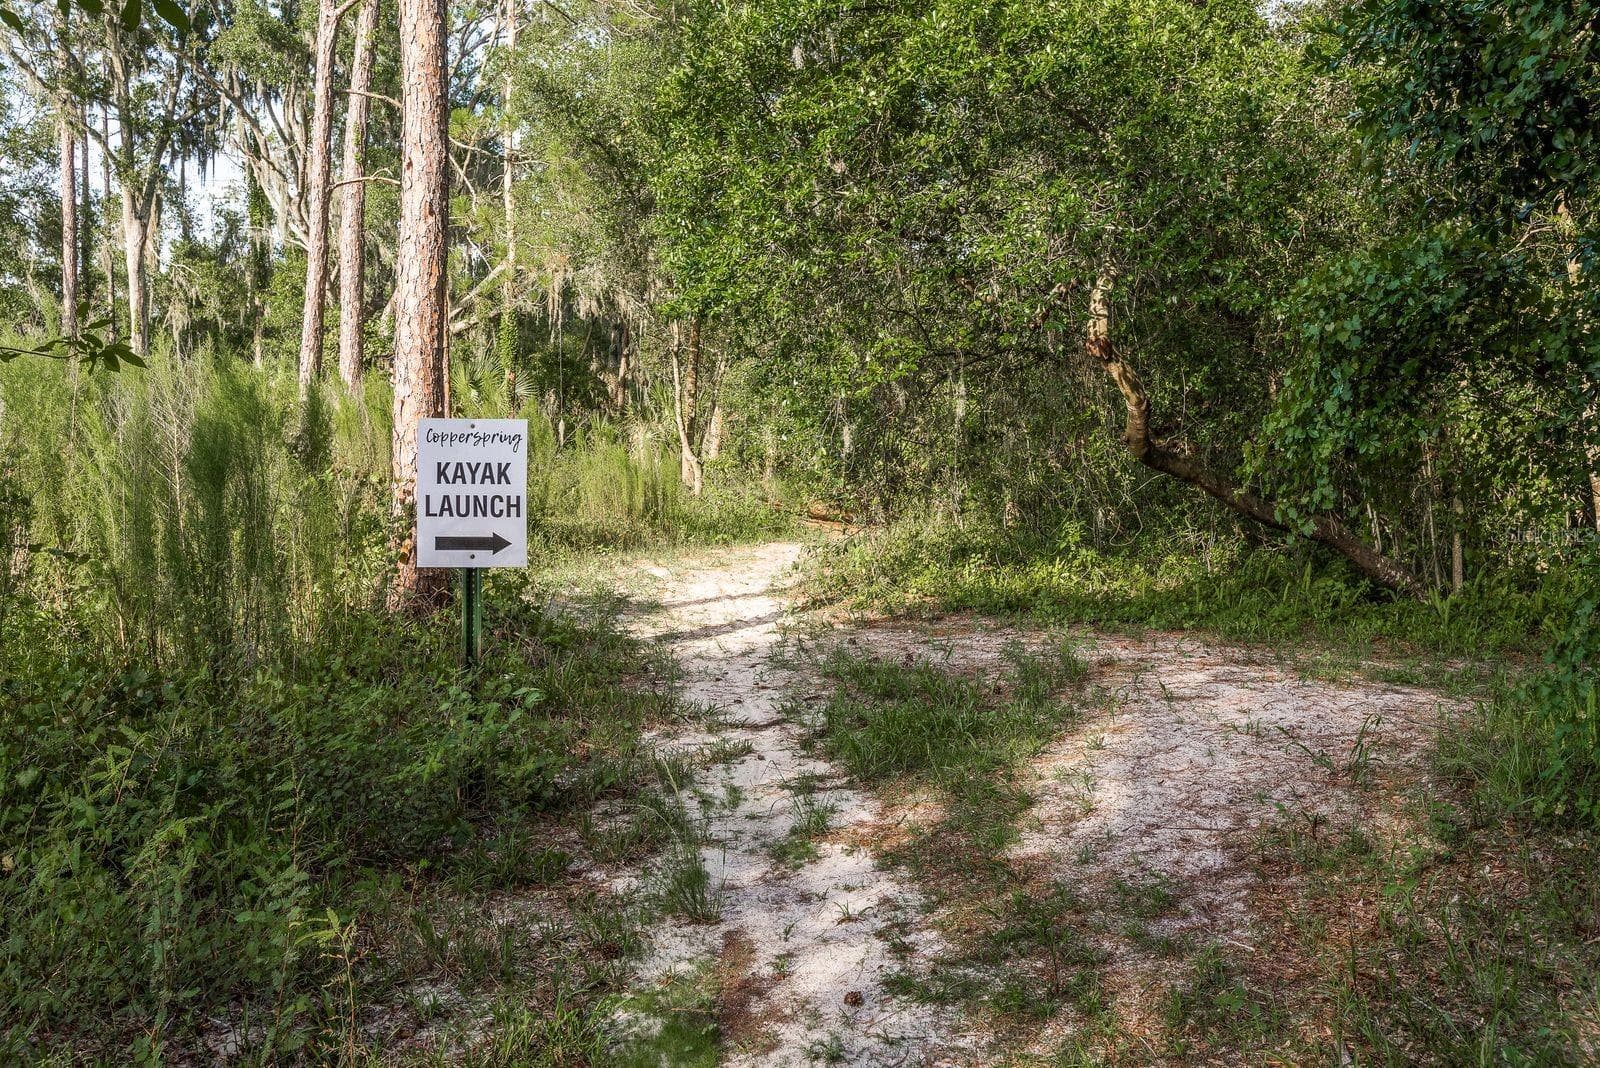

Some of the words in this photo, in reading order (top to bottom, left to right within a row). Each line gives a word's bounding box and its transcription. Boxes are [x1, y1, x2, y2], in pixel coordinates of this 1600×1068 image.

[426, 428, 523, 453] Copperspring
[436, 462, 512, 485] KAYAK
[425, 494, 521, 518] LAUNCH
